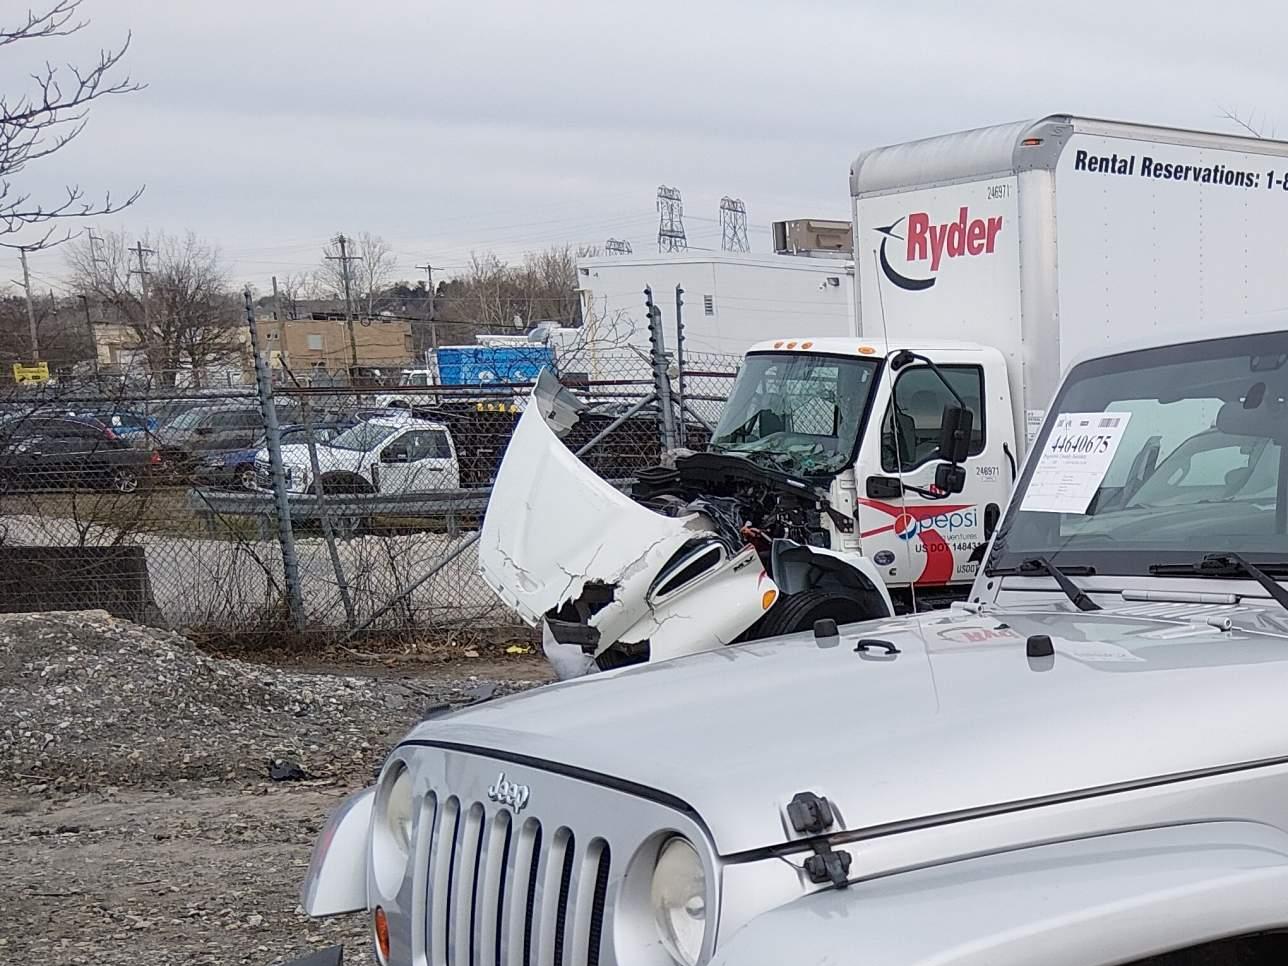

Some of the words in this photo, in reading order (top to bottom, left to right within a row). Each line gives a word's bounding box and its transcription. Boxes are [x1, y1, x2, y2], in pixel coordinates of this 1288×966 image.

[1074, 150, 1135, 176] Rental
[1140, 156, 1260, 189] Reservations:
[987, 184, 1010, 200] 246971
[906, 206, 1003, 272] Ryder
[1051, 434, 1112, 454] 44640675
[975, 466, 1000, 476] 246971
[919, 509, 978, 532] pepsi
[488, 772, 530, 815] Jeep
